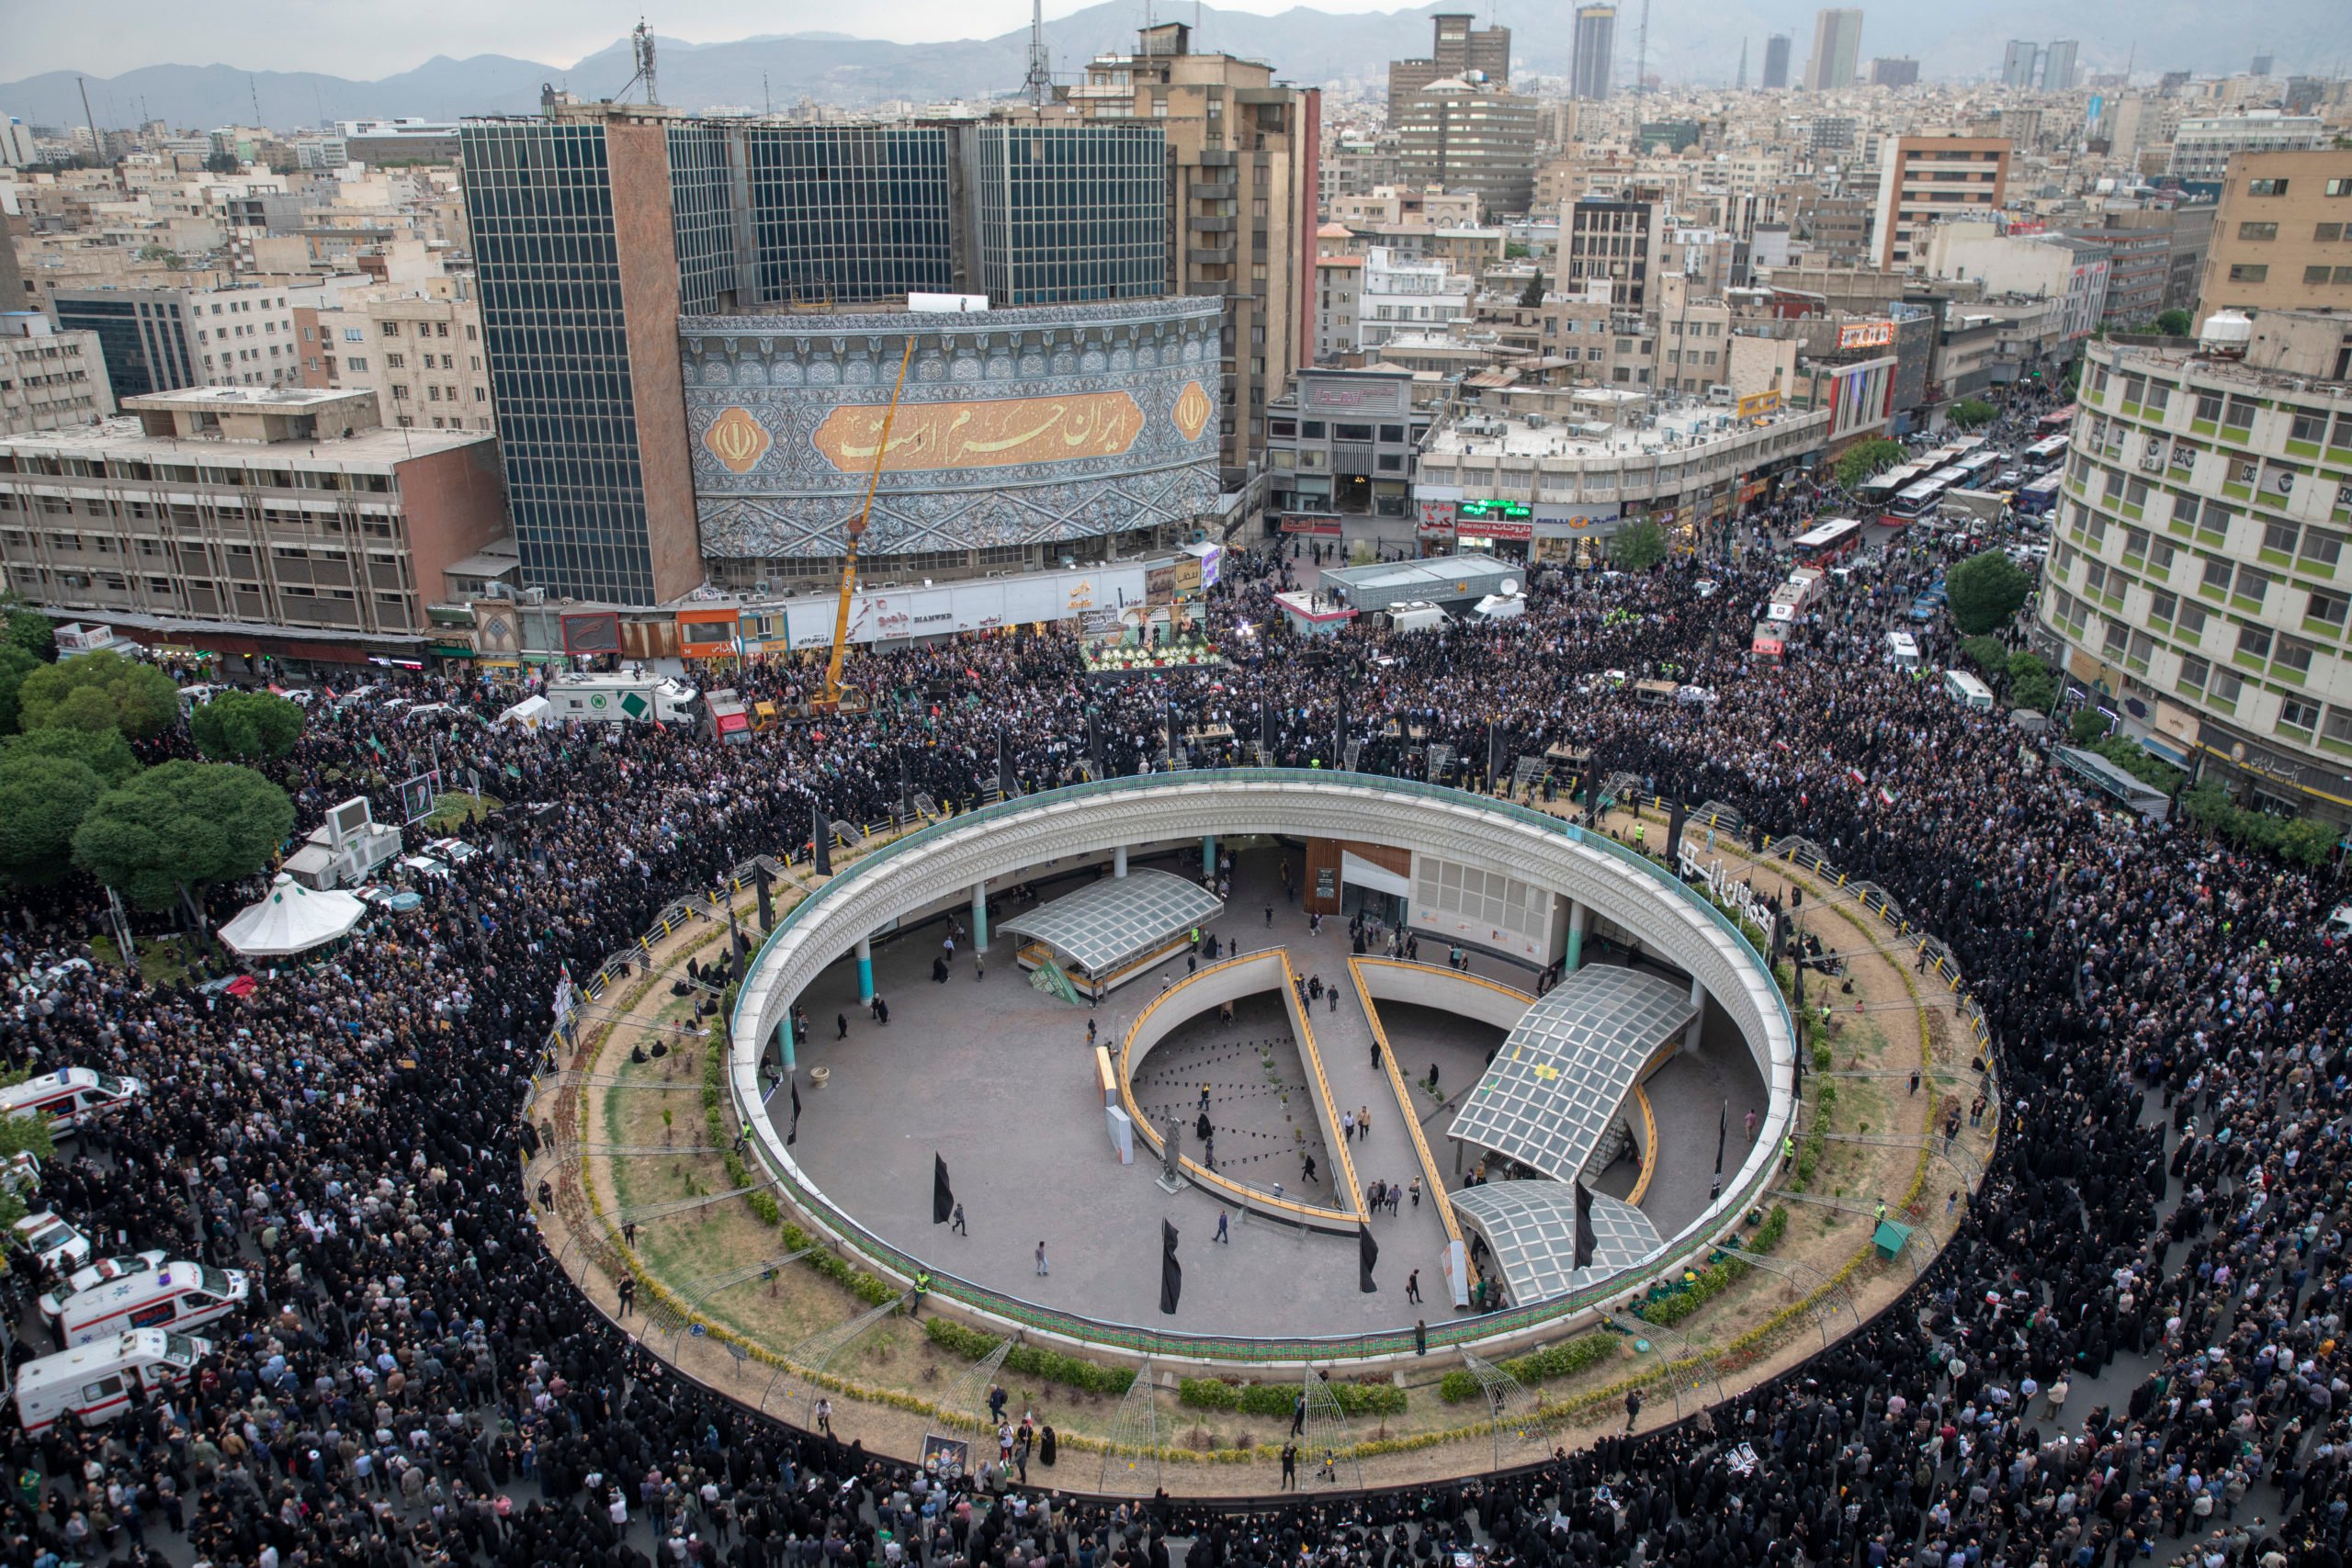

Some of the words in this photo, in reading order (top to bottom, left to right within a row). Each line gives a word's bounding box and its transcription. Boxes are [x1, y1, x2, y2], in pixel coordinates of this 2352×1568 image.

[944, 404, 1069, 464] حرم
[1064, 402, 1126, 452] ایران
[1419, 513, 1453, 534] کیش
[1457, 523, 1491, 531] Pharmacy
[1492, 524, 1531, 533] داروخانه
[913, 613, 952, 624] DIAMWND
[979, 614, 1001, 626] زیبایی
[2251, 756, 2268, 770] ایران
[2272, 764, 2306, 783] بانک
